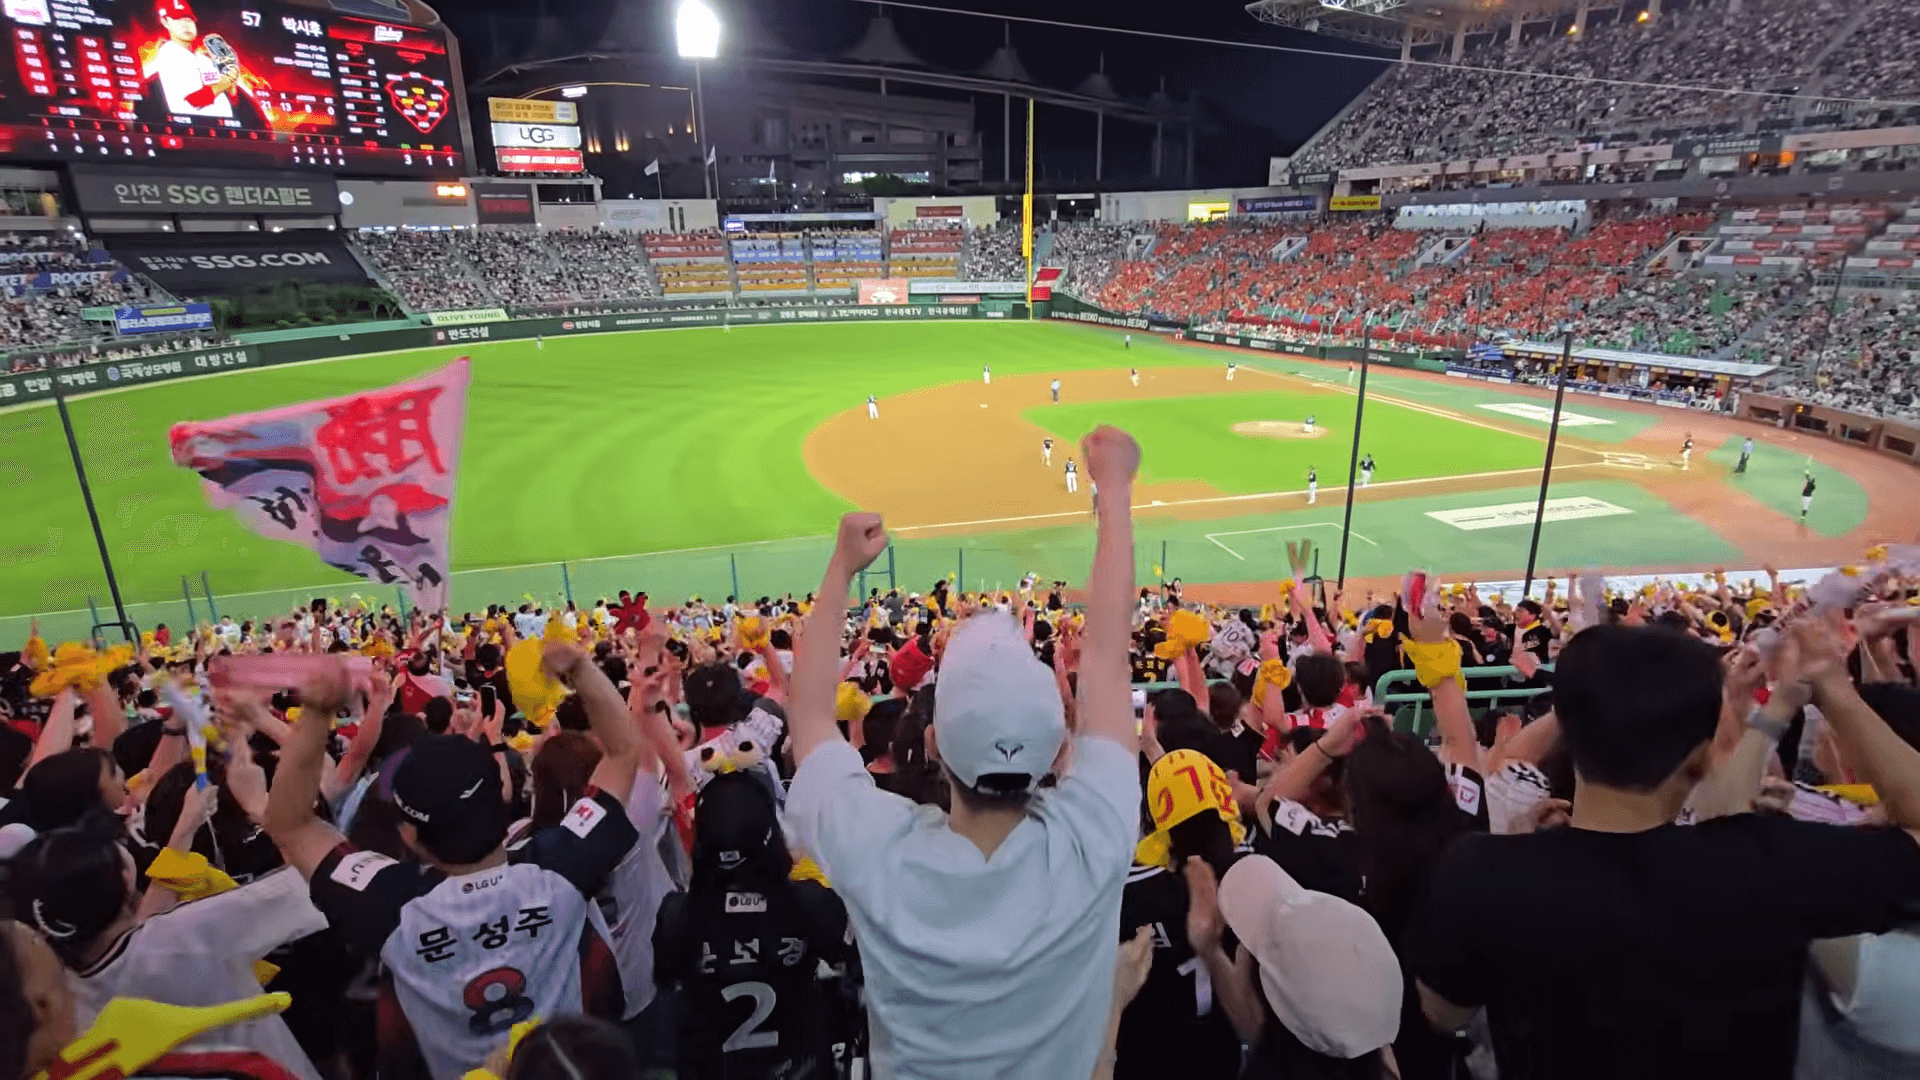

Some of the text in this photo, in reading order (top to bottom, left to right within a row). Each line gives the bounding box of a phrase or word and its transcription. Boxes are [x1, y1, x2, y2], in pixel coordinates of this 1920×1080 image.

[242, 11, 261, 27] 57
[282, 17, 323, 37] 박시후
[520, 127, 554, 144] UGG
[404, 154, 453, 166] 3 1 1
[115, 184, 313, 206] 인천 SSG 랜더스필드
[191, 252, 332, 270] SSG.COM
[436, 313, 466, 322] OLIVE
[1127, 317, 1148, 329] BESKO
[448, 326, 490, 340] 반도건설
[194, 351, 247, 367] 대방건설
[1224, 626, 1239, 642] 10
[475, 880, 489, 890] LG
[416, 906, 553, 963] 문성주
[463, 967, 534, 1034] 8
[721, 981, 779, 1052] 2
